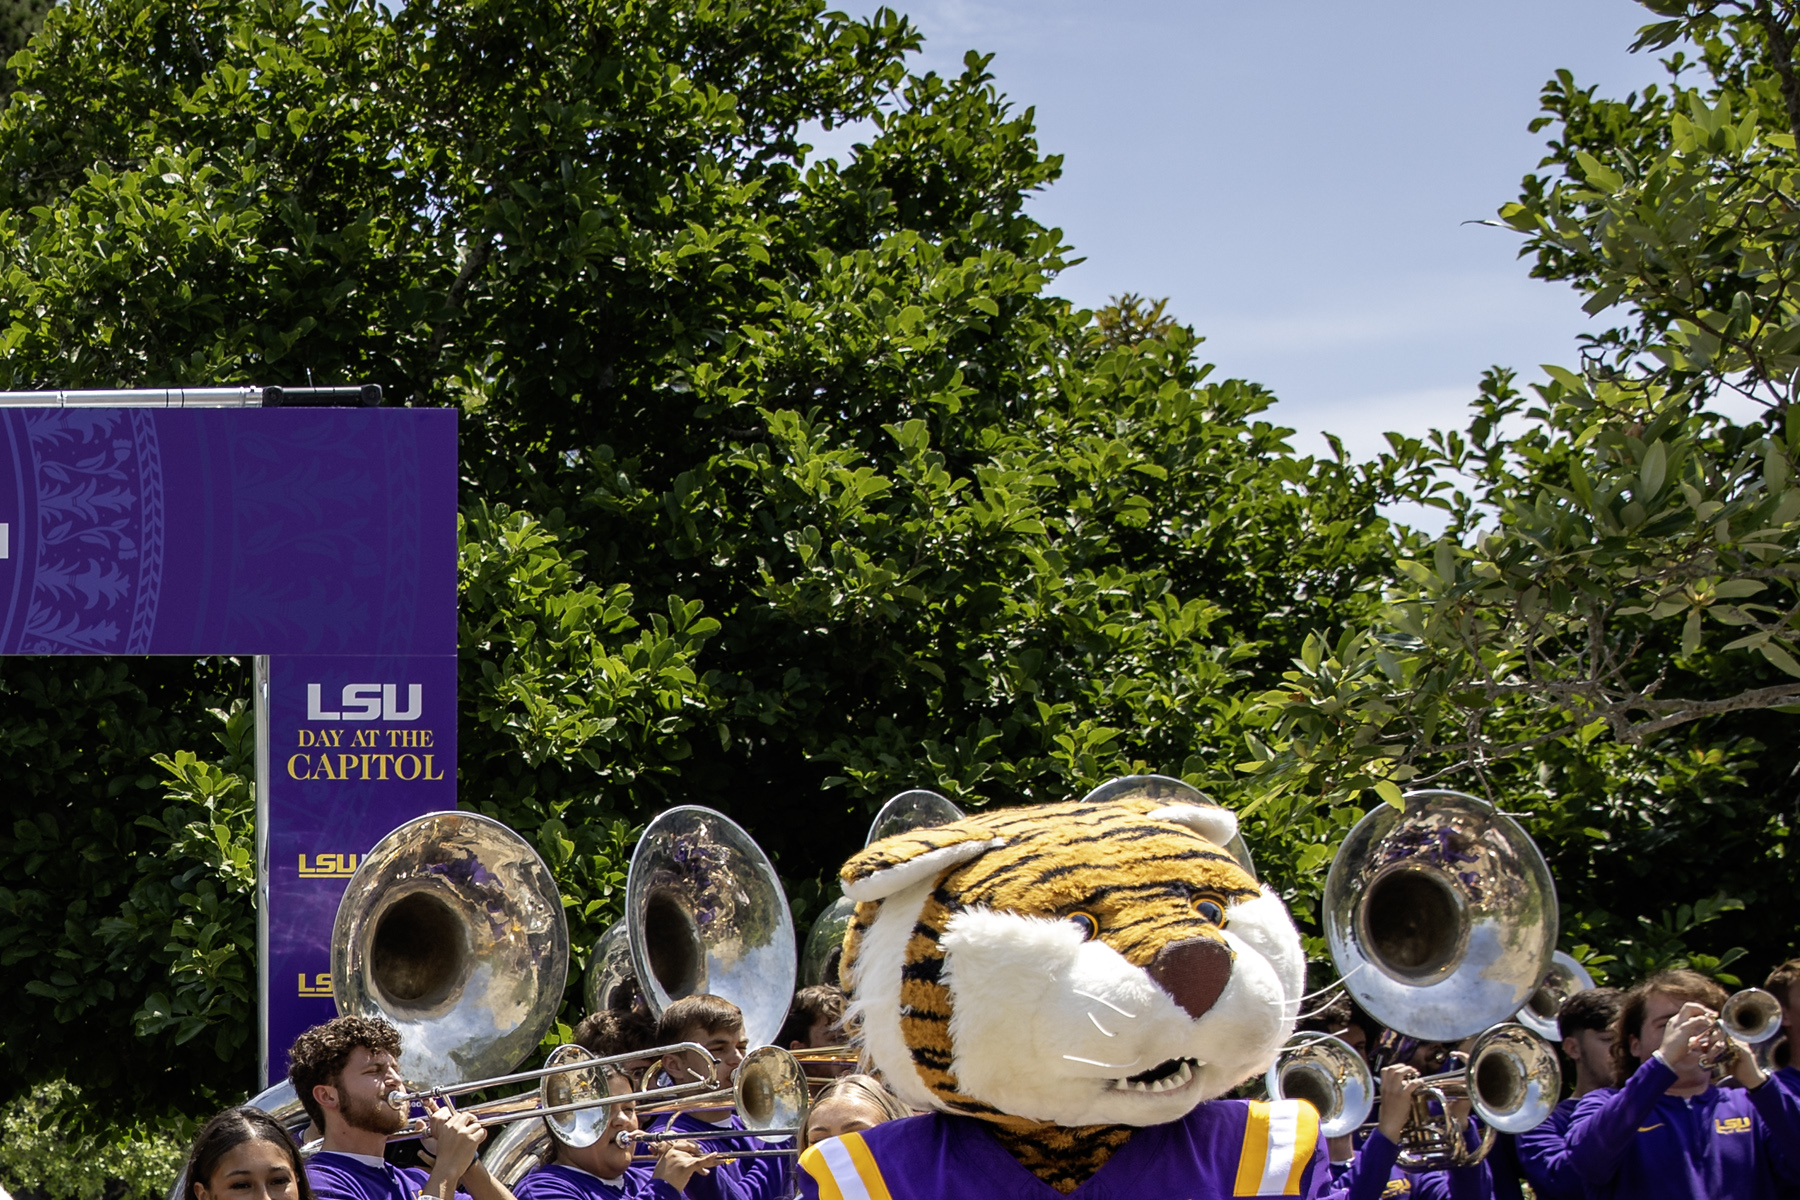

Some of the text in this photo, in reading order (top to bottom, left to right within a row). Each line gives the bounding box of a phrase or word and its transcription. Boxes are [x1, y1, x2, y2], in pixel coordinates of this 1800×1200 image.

[307, 684, 422, 721] LSU
[298, 729, 434, 748] DAY AT THE
[287, 753, 444, 781] CAPITOL
[299, 853, 357, 873] LSU
[298, 973, 334, 992] LS
[1715, 1116, 1751, 1129] LSU
